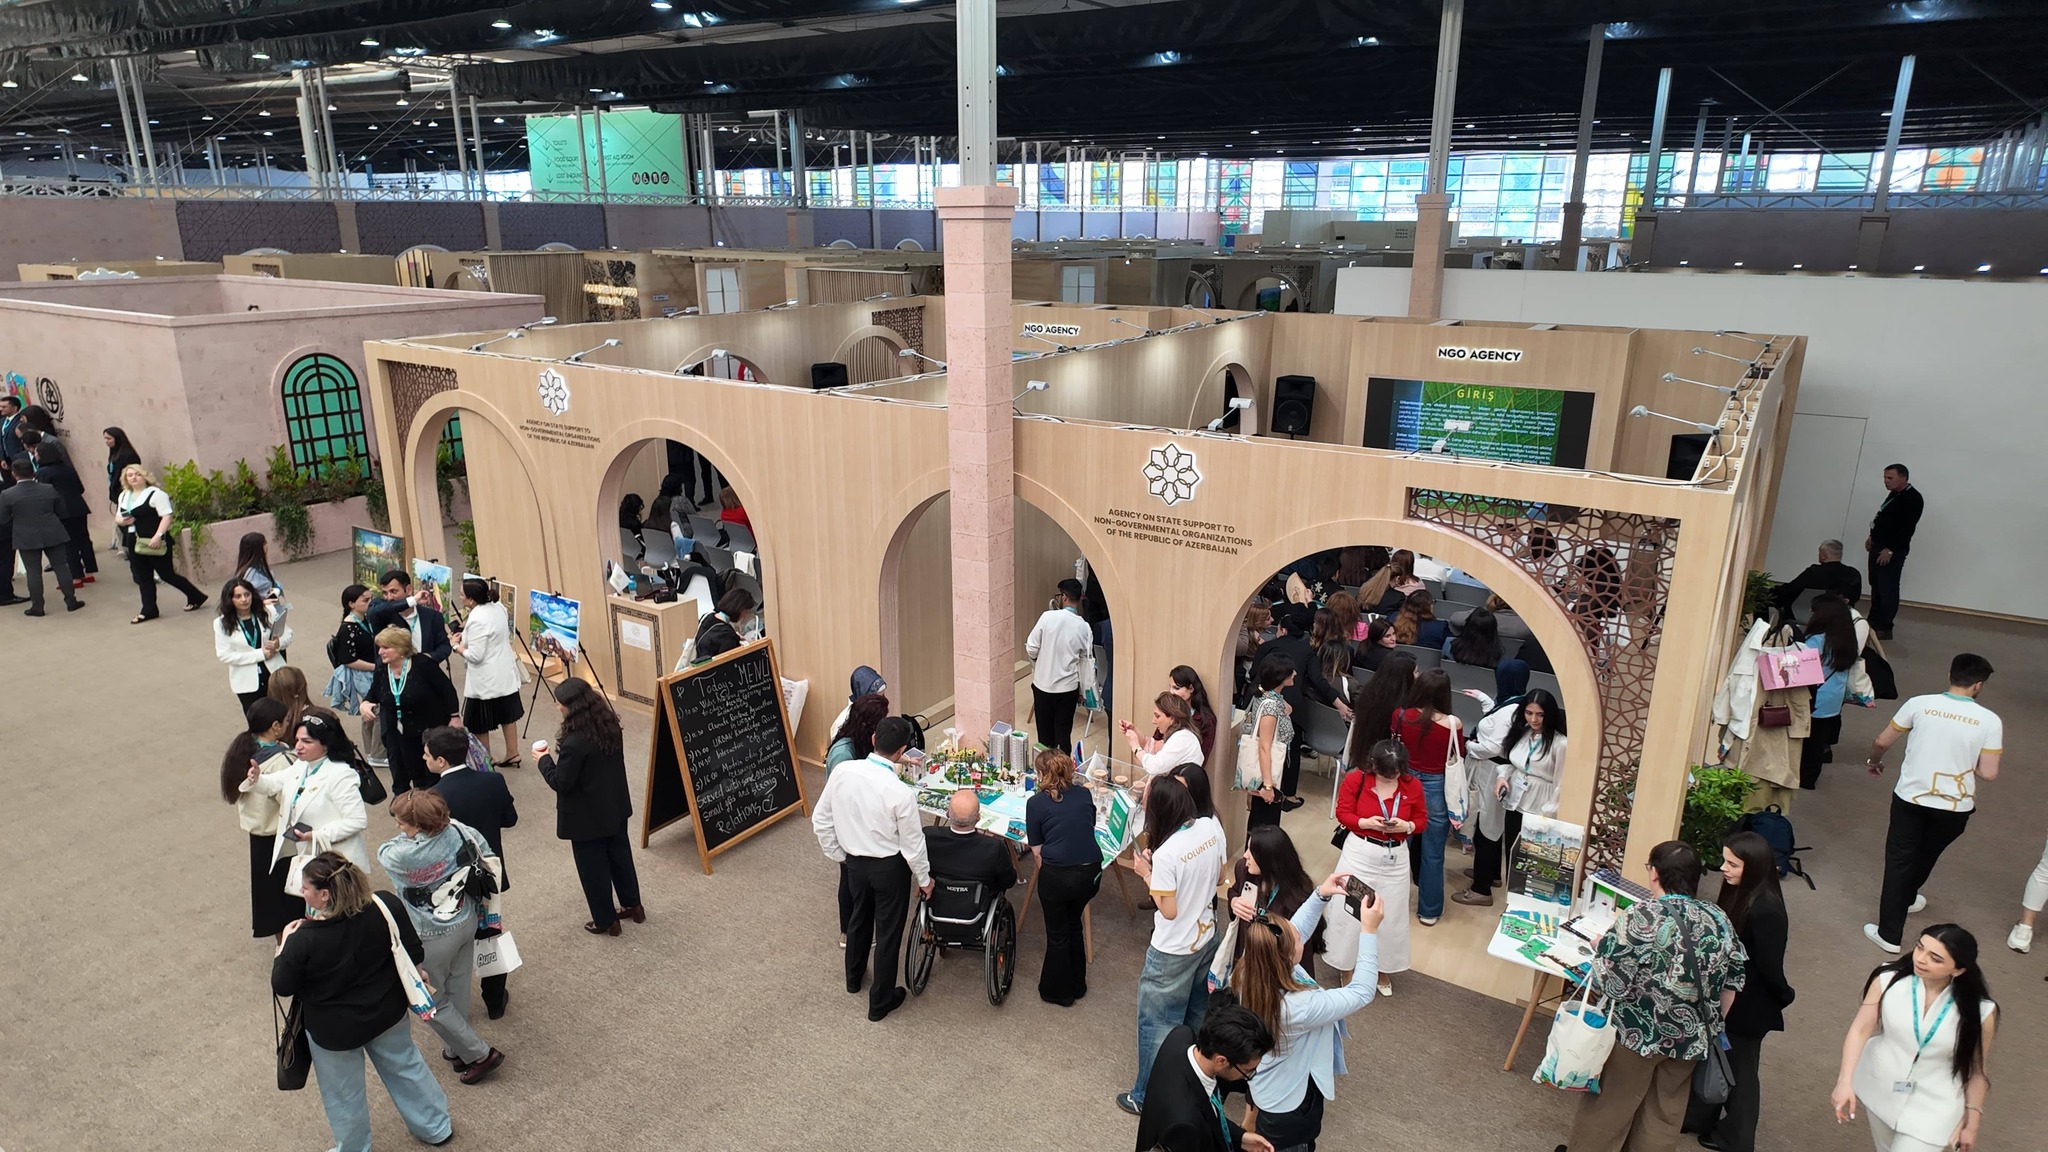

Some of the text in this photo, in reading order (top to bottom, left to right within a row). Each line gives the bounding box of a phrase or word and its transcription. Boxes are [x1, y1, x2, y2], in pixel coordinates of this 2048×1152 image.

[1024, 324, 1079, 335] NGO AGENCY
[1438, 348, 1521, 361] NGO AGENCY
[1457, 388, 1495, 402] GİRİŞ
[1108, 508, 1235, 534] AGENCY ON STATE SUPPORT TO
[1094, 516, 1253, 547] NON-GOVERNMENTAL ORGANIZATIONS
[1106, 528, 1238, 555] OF THE REPUBLIC OF AZERBAIJAN
[1924, 708, 1980, 727] VOLUNTEER
[715, 801, 762, 834] Relations
[477, 951, 498, 968] Aura
